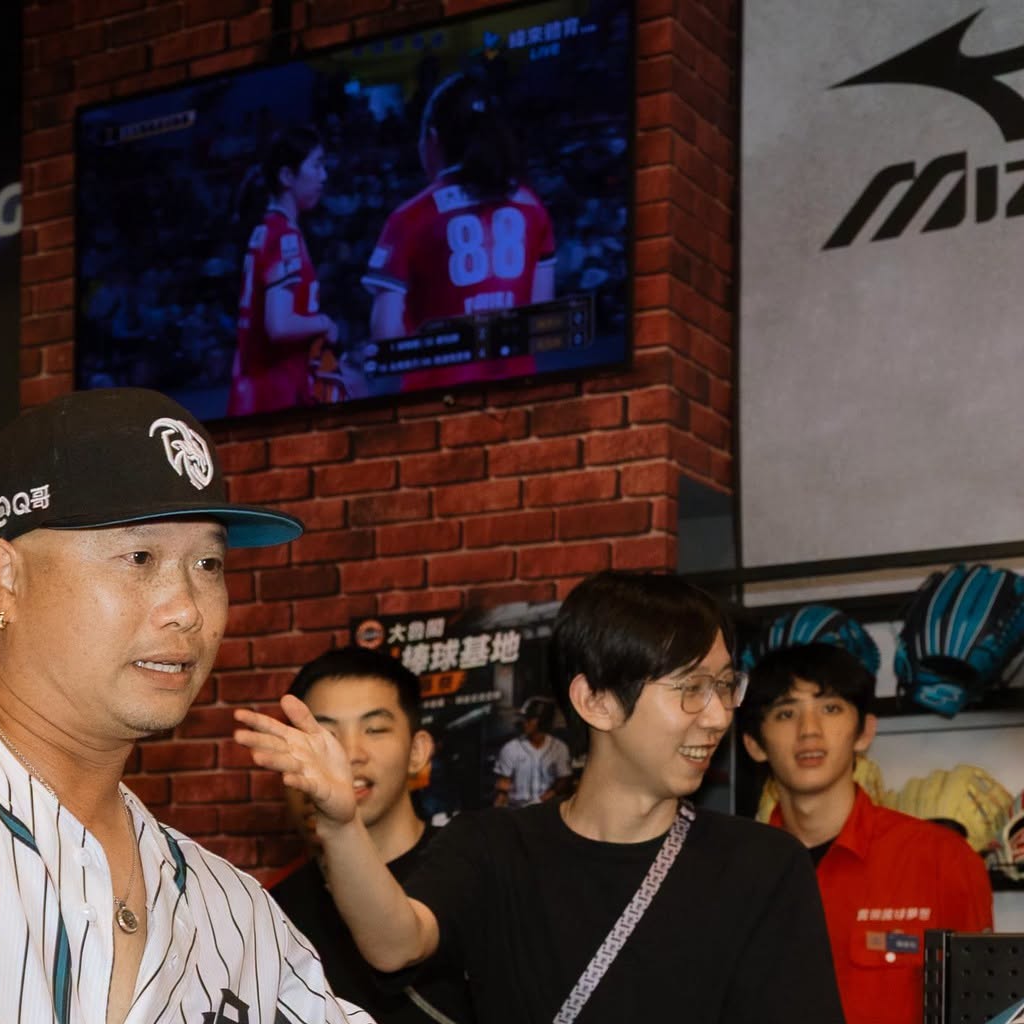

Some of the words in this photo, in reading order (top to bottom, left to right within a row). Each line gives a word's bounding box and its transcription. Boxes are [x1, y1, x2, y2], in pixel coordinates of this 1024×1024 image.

[446, 206, 526, 288] 88
[401, 629, 522, 676] 棒球基地
